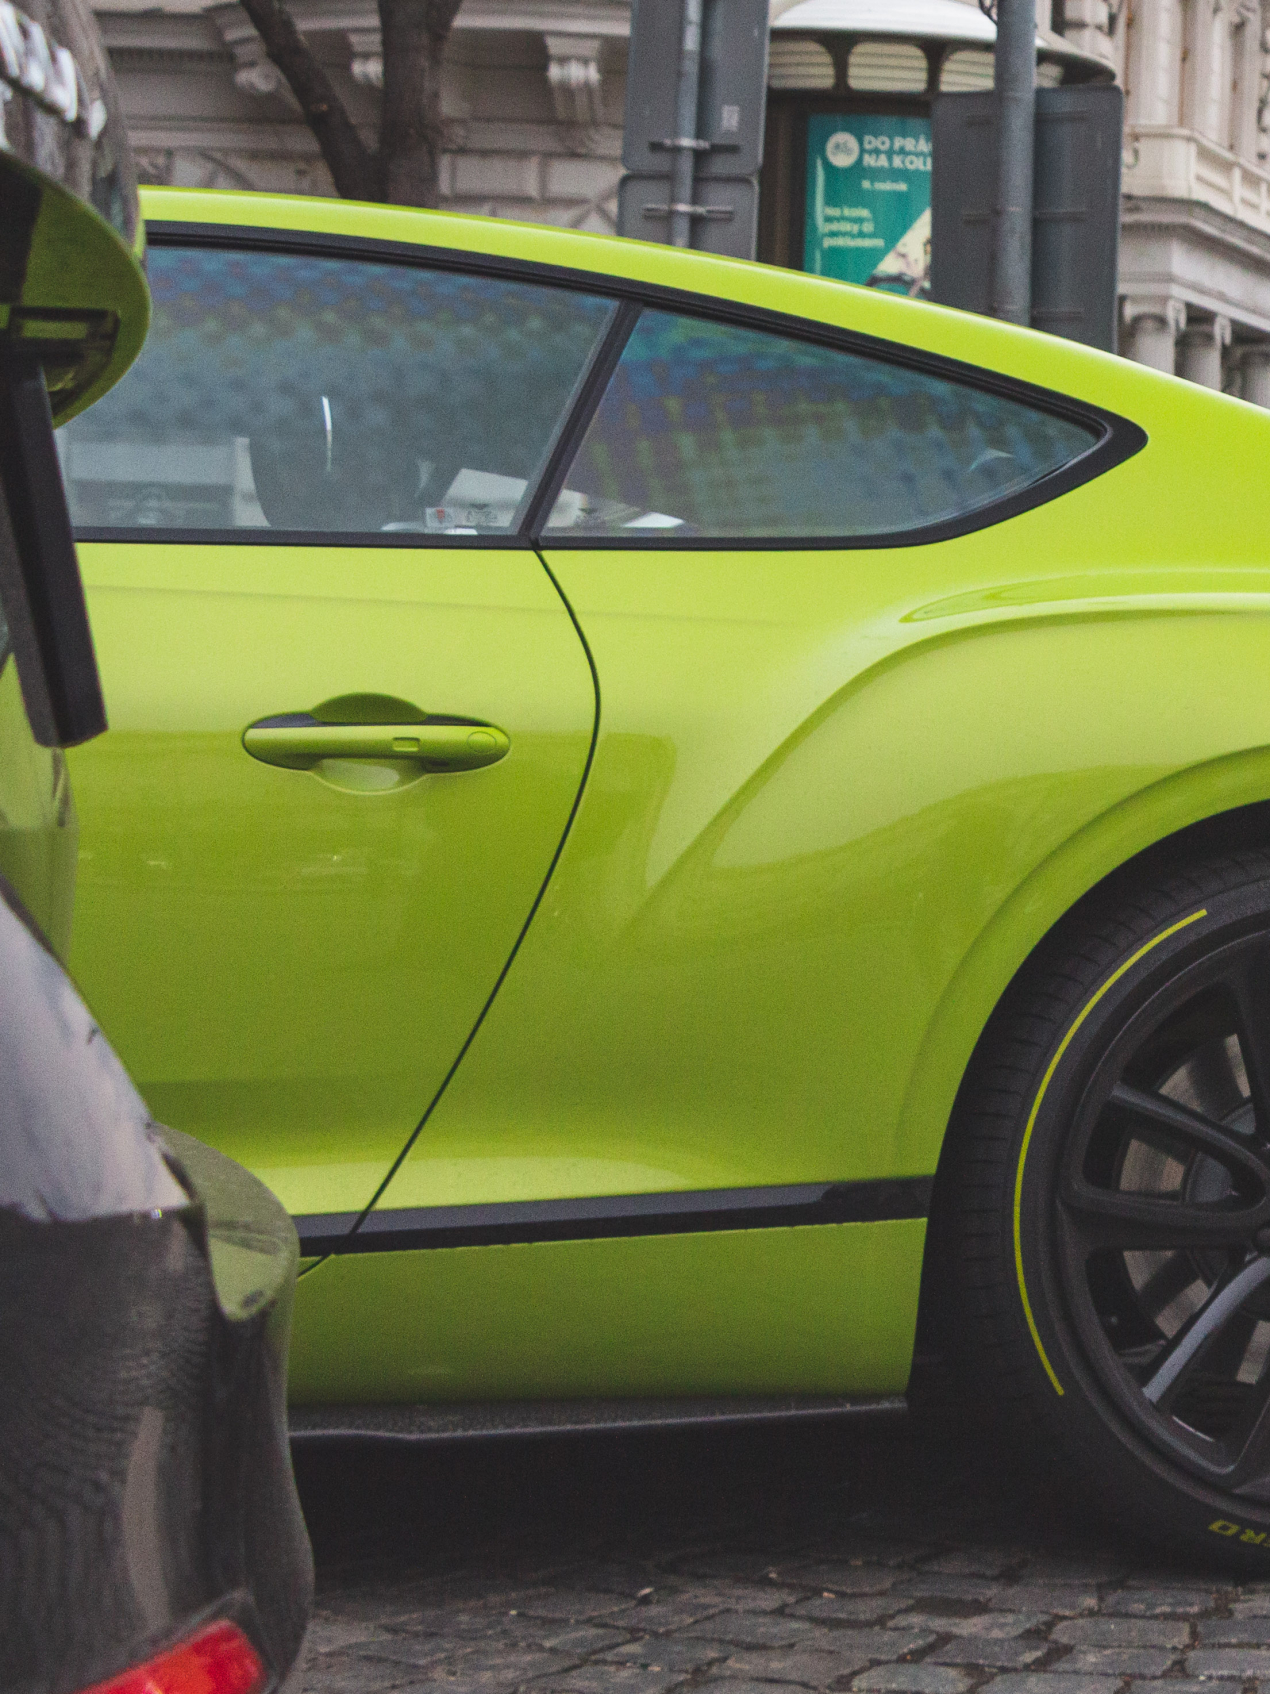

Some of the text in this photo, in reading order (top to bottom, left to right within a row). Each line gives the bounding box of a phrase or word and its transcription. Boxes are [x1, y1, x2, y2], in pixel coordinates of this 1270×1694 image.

[862, 133, 932, 154] DO PRÁ
[862, 153, 889, 168] NA
